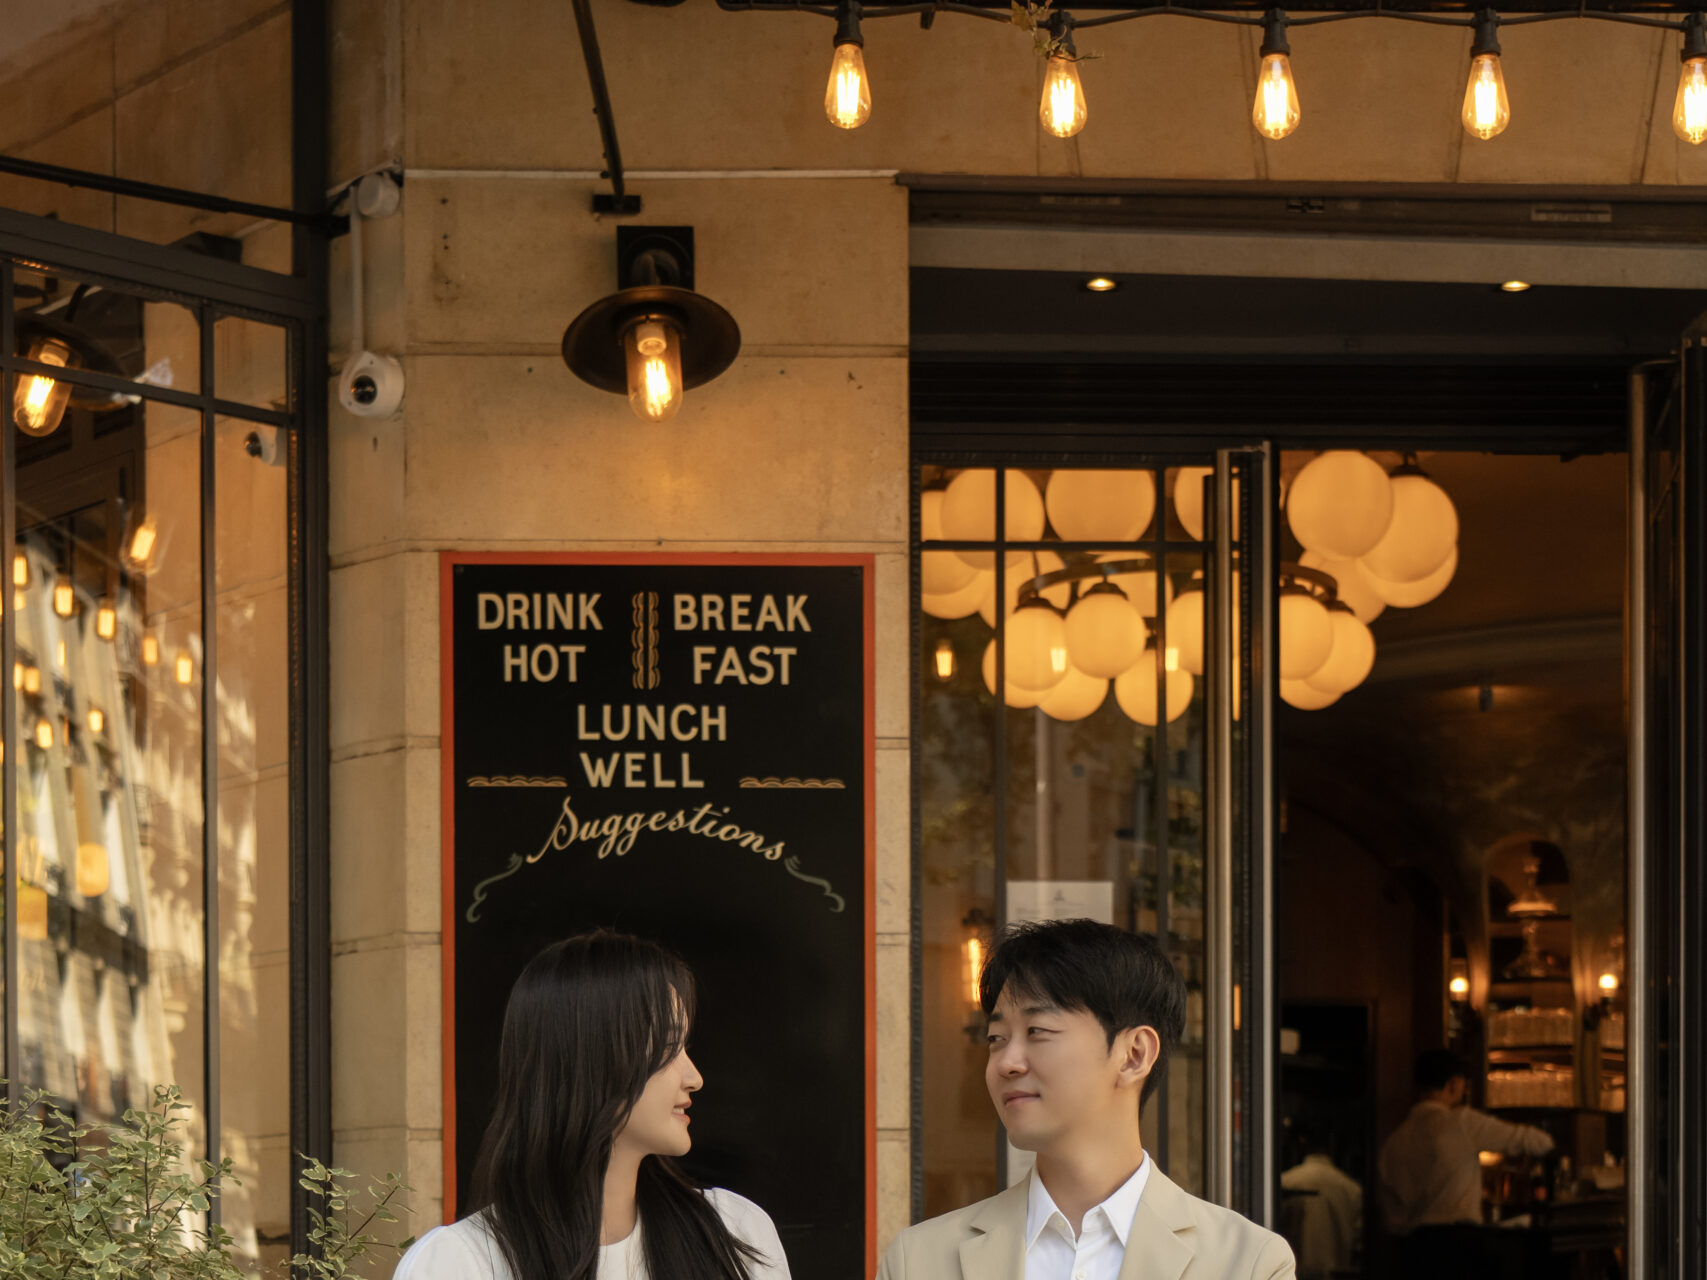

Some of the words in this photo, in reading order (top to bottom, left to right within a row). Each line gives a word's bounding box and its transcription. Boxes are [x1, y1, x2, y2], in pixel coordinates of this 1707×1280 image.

[477, 593, 603, 630] DRINK
[673, 594, 812, 633] BREAK
[503, 644, 587, 683] HOT
[693, 646, 798, 686] FAST
[577, 704, 727, 741] LUNCH
[579, 752, 705, 788] WELL
[526, 796, 785, 863] Suggestions
